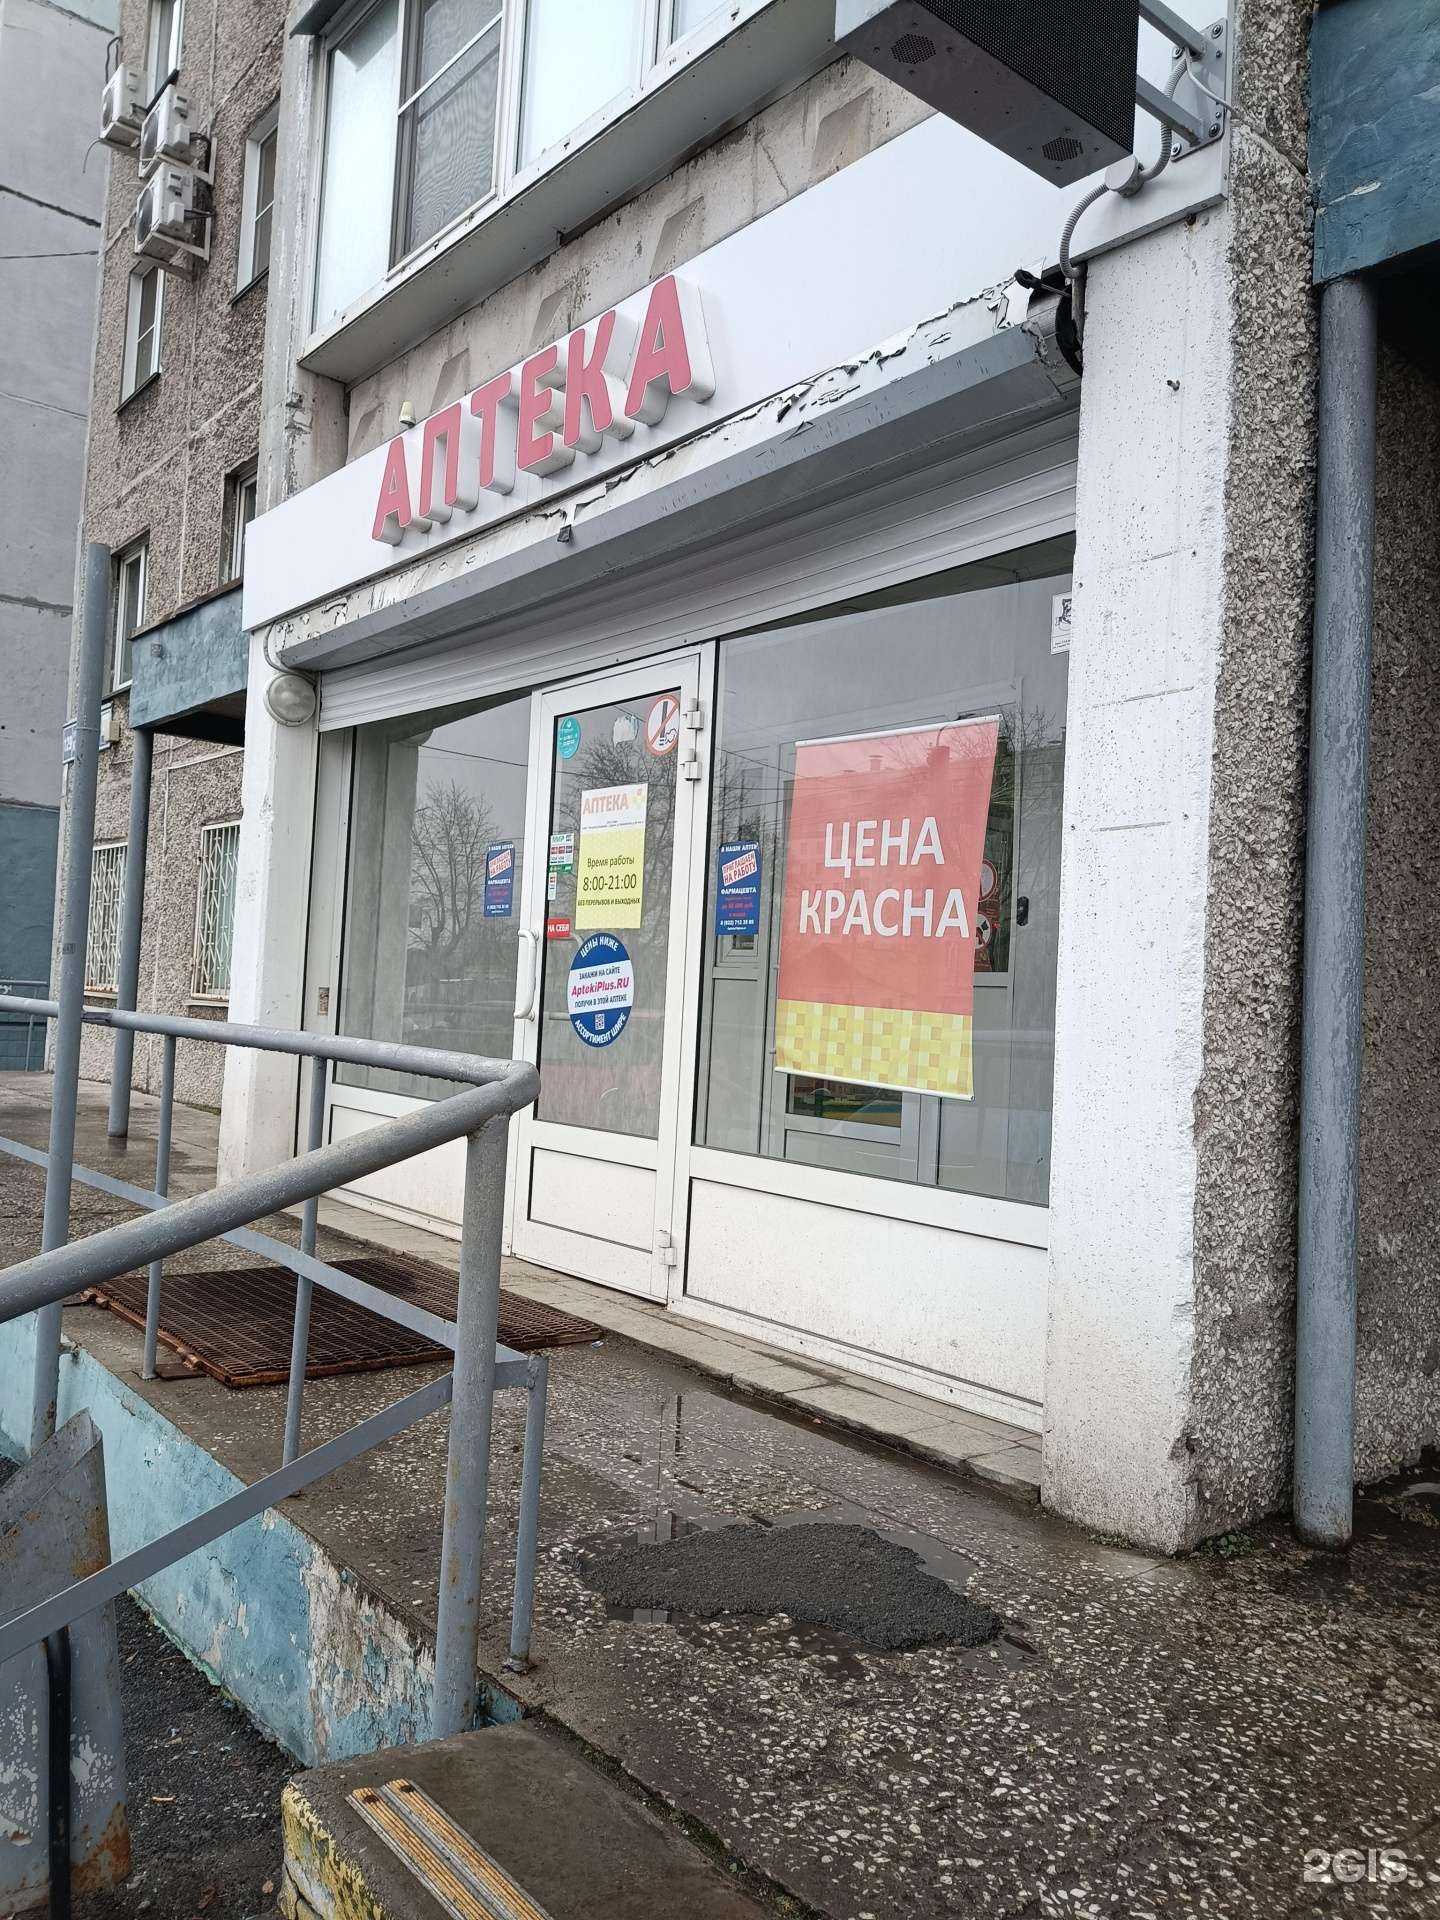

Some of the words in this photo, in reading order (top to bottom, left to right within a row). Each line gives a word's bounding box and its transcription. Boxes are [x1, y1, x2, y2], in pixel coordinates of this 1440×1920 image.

[372, 274, 692, 540] АПТЕКА
[583, 793, 629, 815] АПТЕКА
[824, 816, 945, 878] ЦЕНА
[587, 857, 608, 870] Время
[609, 854, 635, 868] работы
[582, 874, 637, 892] 8:00-21:00
[724, 874, 733, 884] НА
[734, 863, 755, 880] РАБОТУ
[720, 887, 757, 895] ФАРМАЦЕВТА
[799, 888, 970, 938] КРАСНА
[580, 939, 598, 958] ЦЕНЫ
[600, 936, 619, 951] НИЖЕ
[571, 977, 630, 998] AptekiPlus.RU
